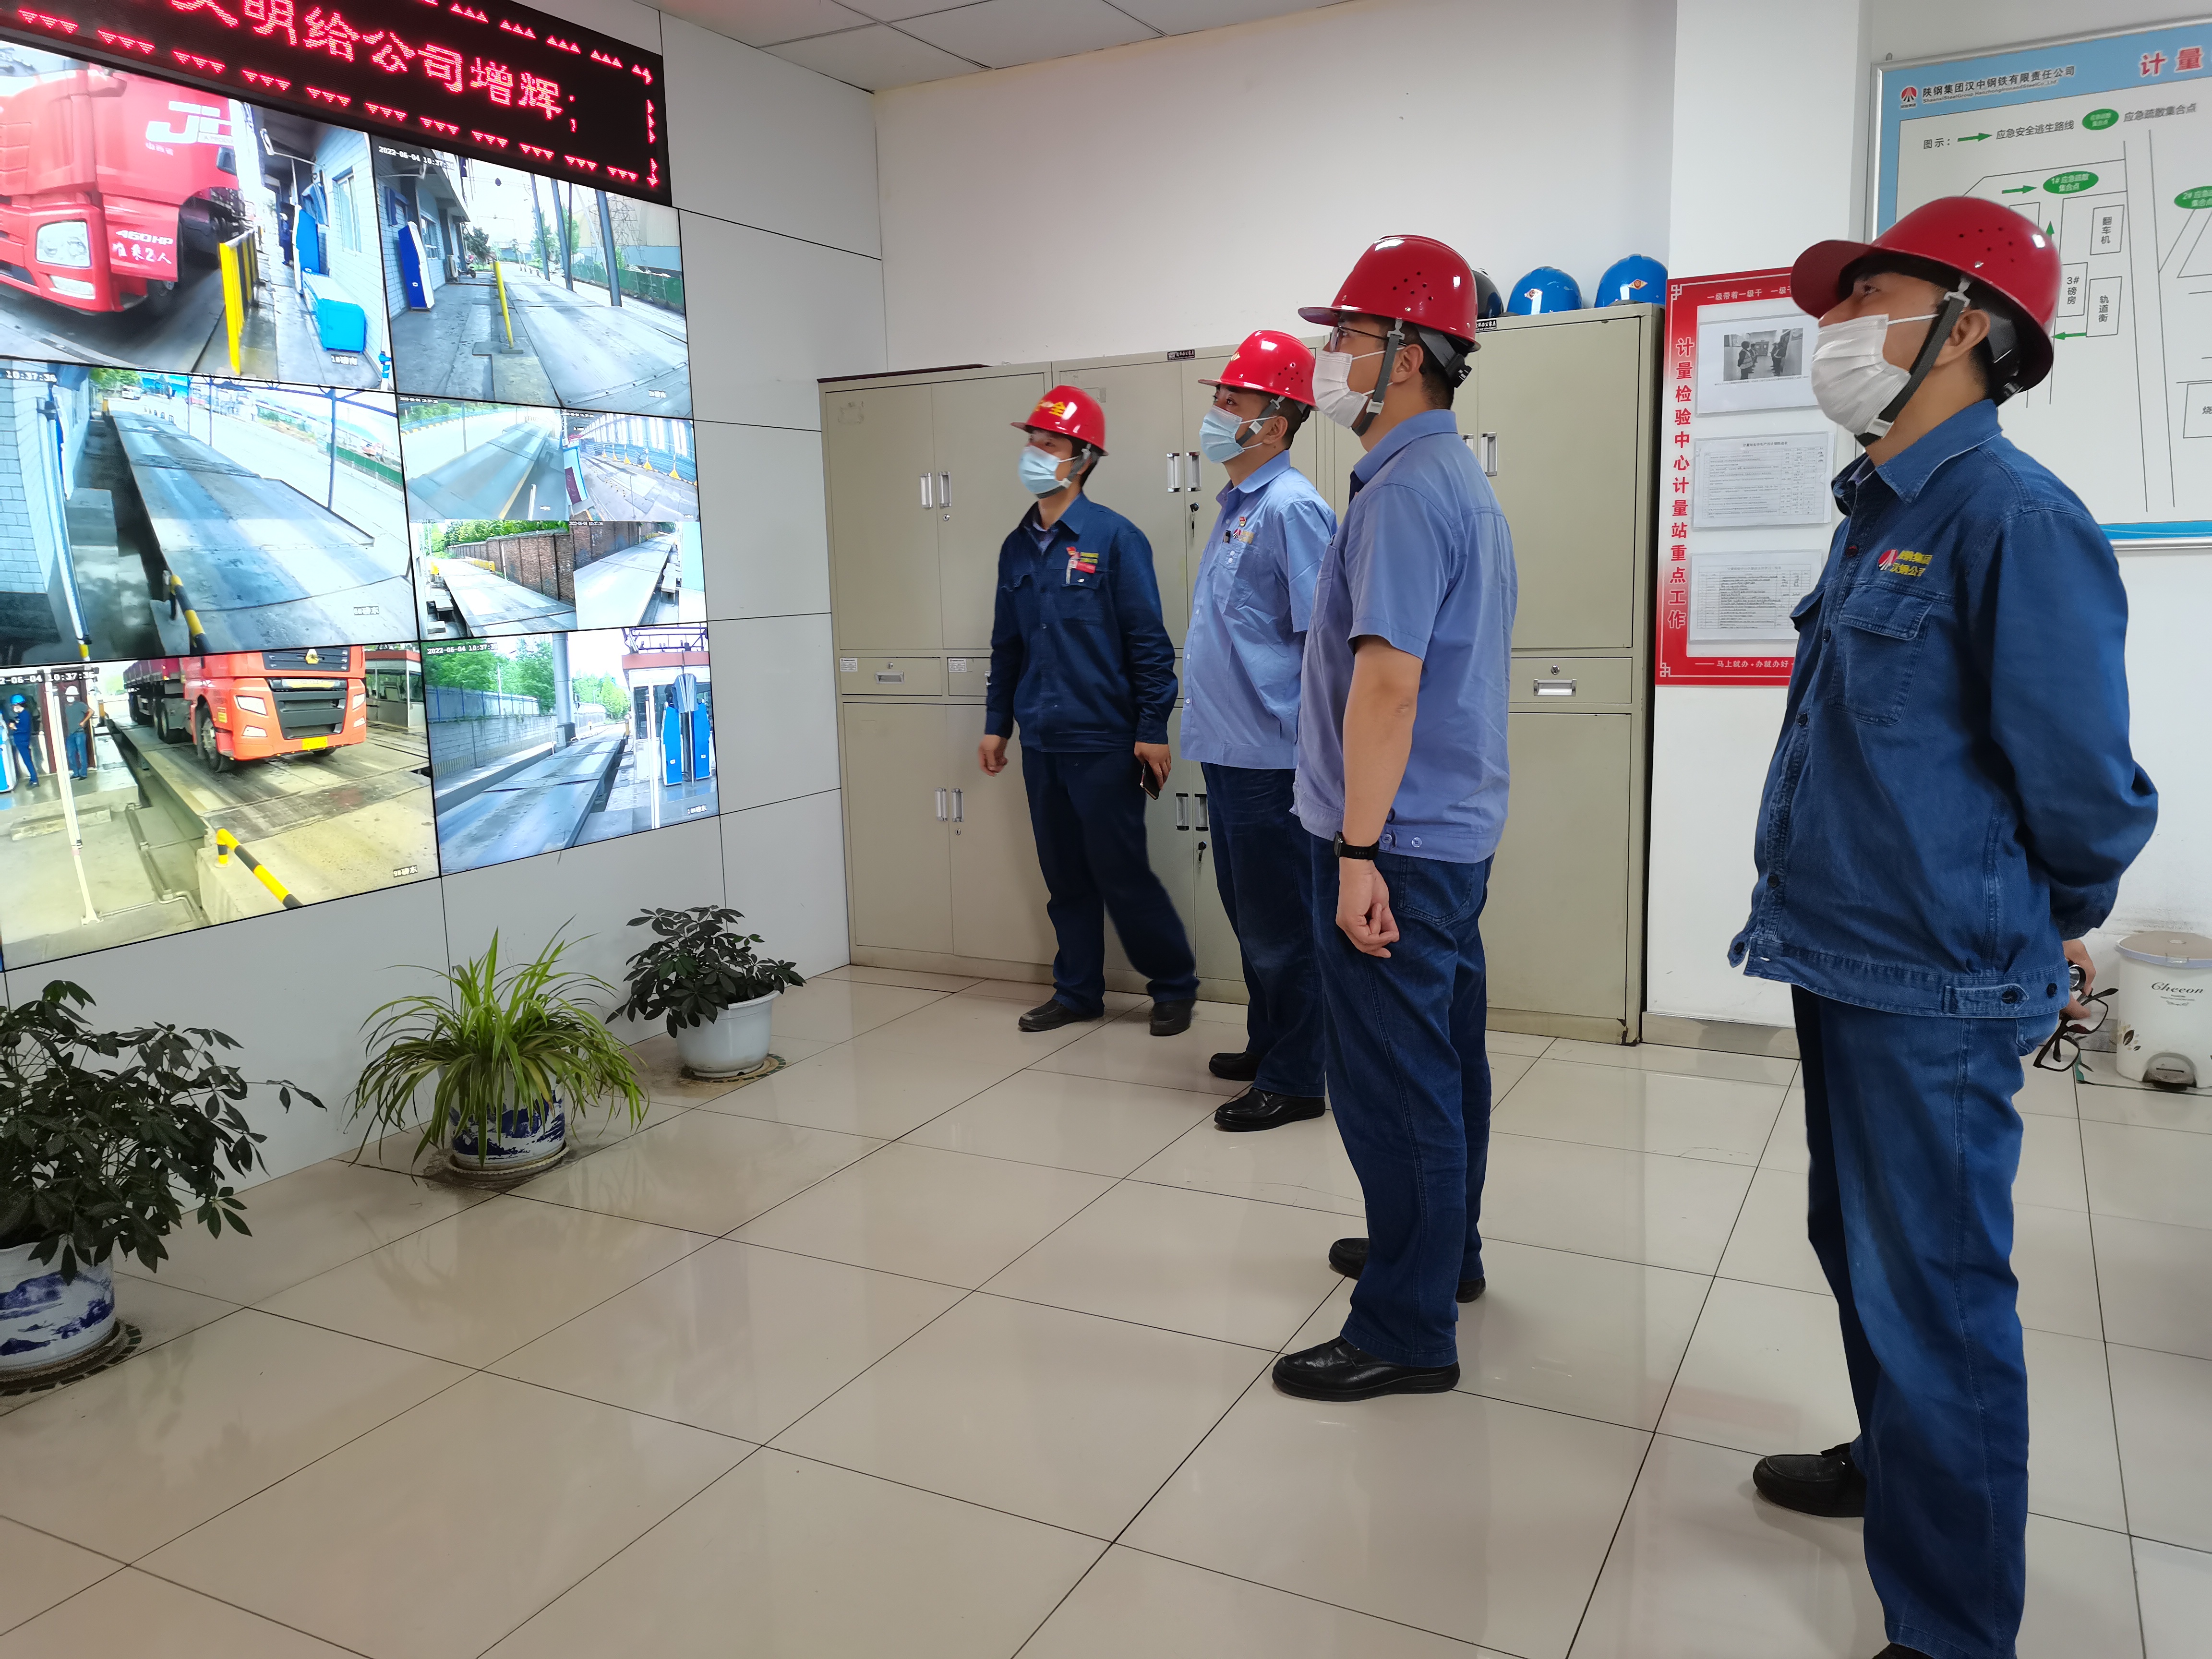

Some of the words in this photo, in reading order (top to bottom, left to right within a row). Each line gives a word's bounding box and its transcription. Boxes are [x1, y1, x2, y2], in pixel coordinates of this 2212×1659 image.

[2140, 47, 2201, 76] 计量
[1922, 66, 2075, 97] 陕钢集团汉中钢铁有限责任公司
[2123, 103, 2197, 122] 应急疏散集合点
[1996, 120, 2075, 140] 应急安全逃生路线
[378, 145, 421, 162] 2022-06-04
[116, 230, 173, 245] 460HP
[2101, 216, 2112, 244] 翻车机
[2067, 276, 2080, 285] 3#
[1707, 289, 1762, 301] 一级带着一级干
[2067, 287, 2077, 305] 磅房
[2098, 295, 2109, 323] 轨道衡
[5, 370, 57, 382] 10:37:36
[1668, 337, 1695, 629] 计量检验中心计量站重点工作
[427, 645, 466, 654] 2022-06-04
[48, 671, 95, 682] 10:37:36
